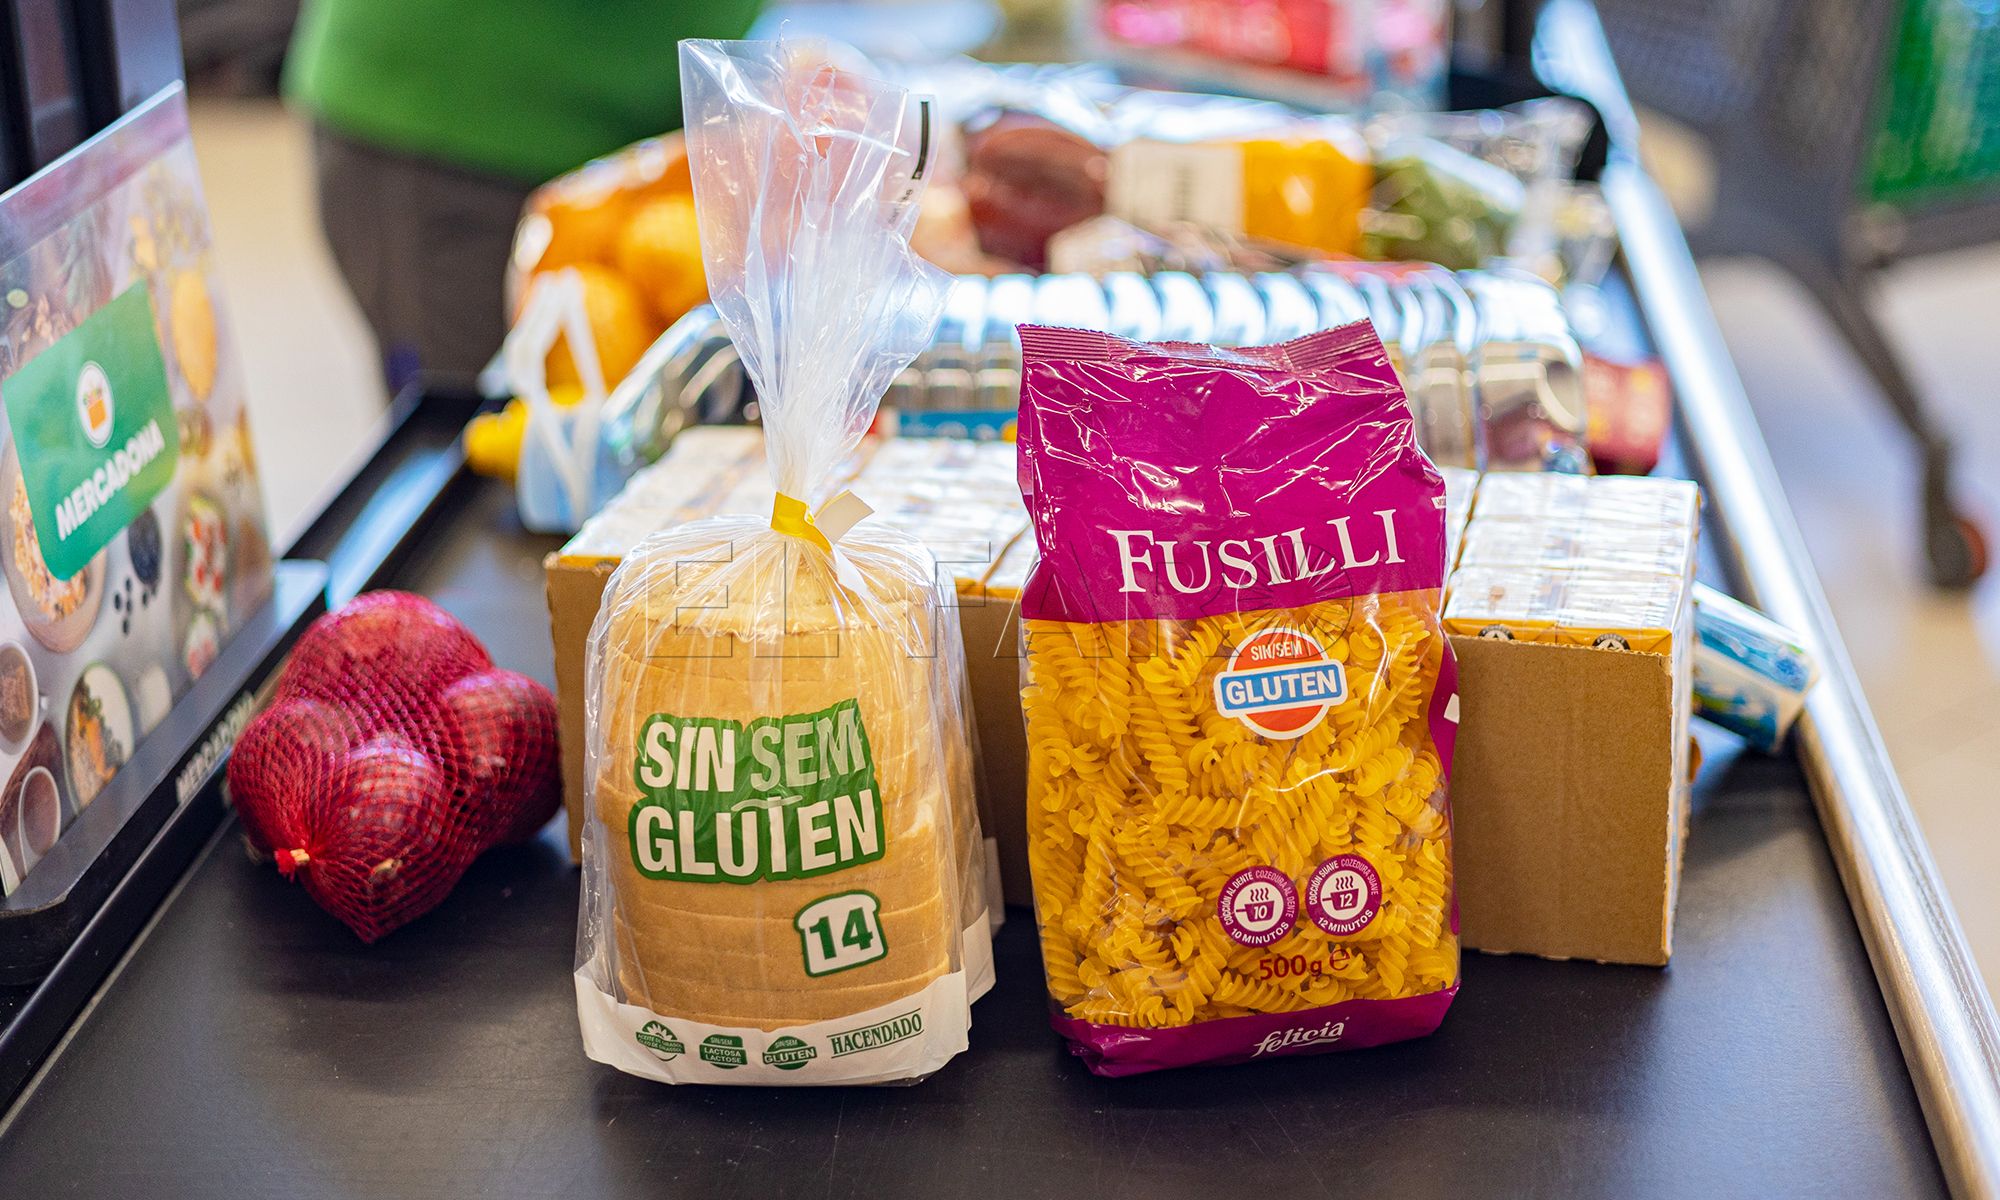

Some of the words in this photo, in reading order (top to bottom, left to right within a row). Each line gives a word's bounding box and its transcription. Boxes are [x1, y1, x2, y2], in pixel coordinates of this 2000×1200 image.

[56, 419, 165, 540] MERCADONA
[1107, 508, 1405, 594] FUSILLI
[1225, 669, 1337, 705] GLUTEN
[640, 721, 735, 792] SIN
[750, 707, 867, 792] SEM
[635, 788, 879, 877] GLUTEN
[1318, 860, 1339, 878] SUAVE
[1226, 887, 1237, 896] AL
[1232, 871, 1254, 889] DENTE
[1284, 886, 1293, 897] AL
[1367, 873, 1379, 896] SUAVE
[1253, 905, 1268, 920] 10
[1340, 893, 1353, 908] 12
[1231, 928, 1242, 939] 10
[1242, 922, 1289, 944] MINUTOS
[1318, 917, 1329, 929] 12
[1328, 909, 1374, 933] MINUTOS
[810, 907, 874, 960] 14
[830, 1013, 922, 1055] HACENDADO
[1250, 1021, 1345, 1058] felicia
[704, 1047, 742, 1057] LACTOSA
[705, 1054, 742, 1063] LACTOSE
[764, 1049, 816, 1063] GLUTEN
